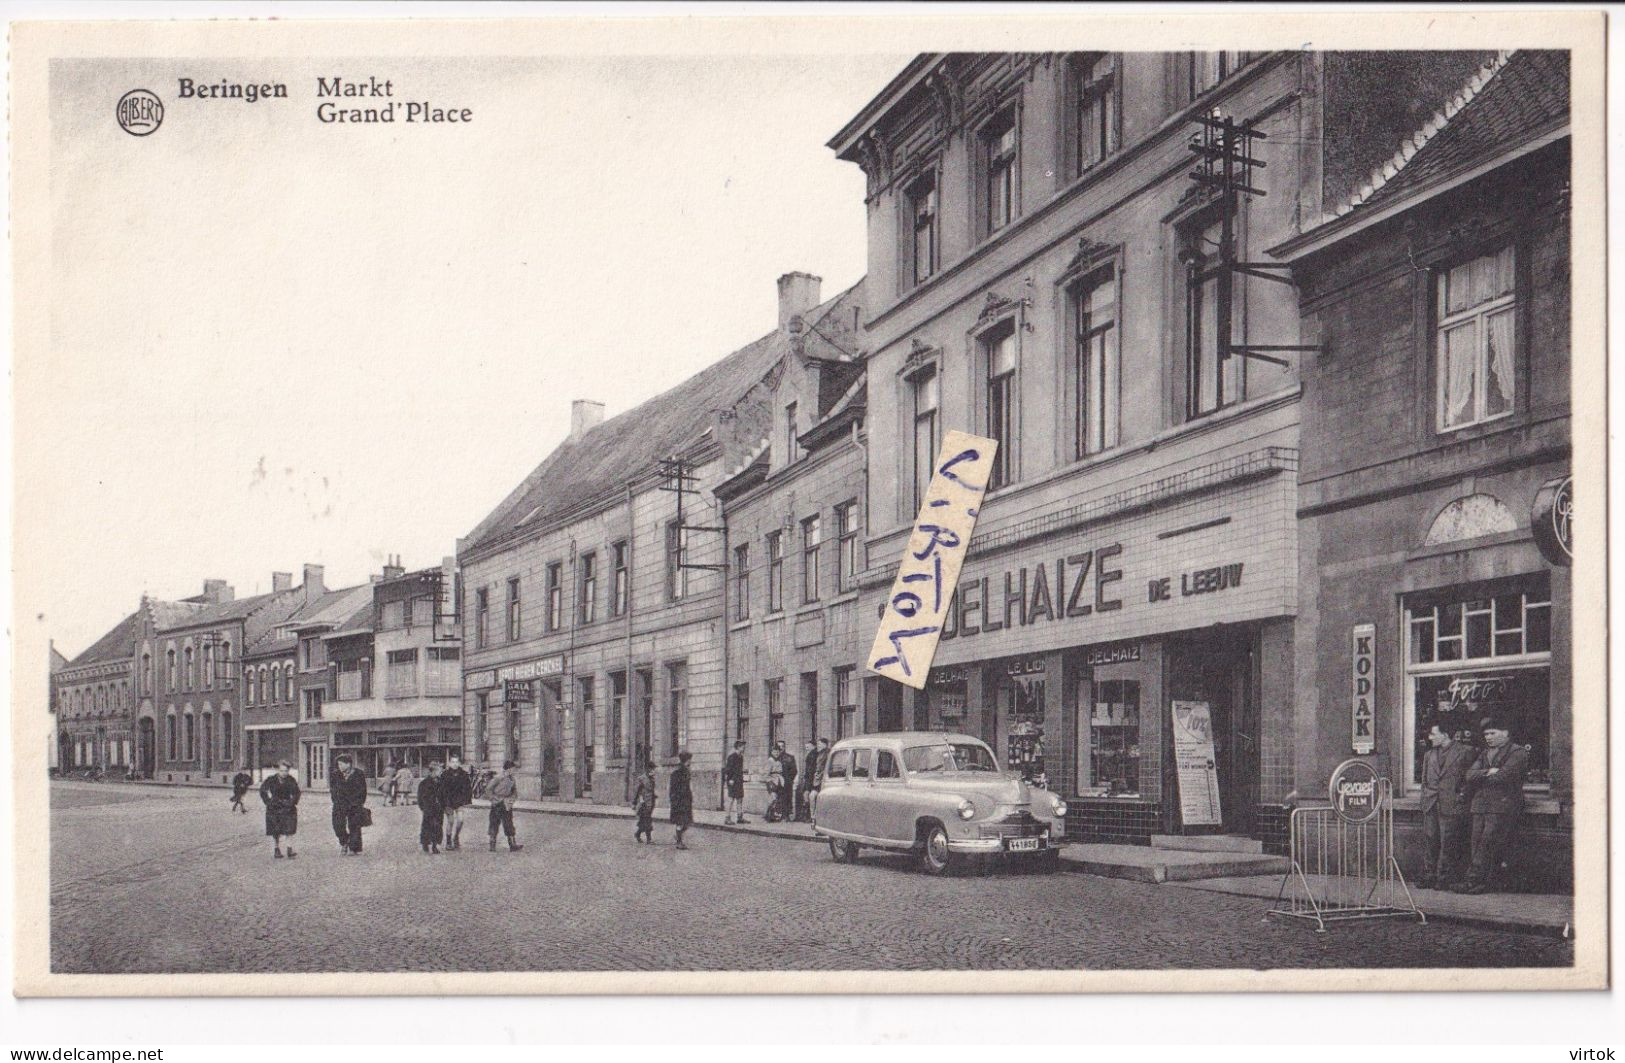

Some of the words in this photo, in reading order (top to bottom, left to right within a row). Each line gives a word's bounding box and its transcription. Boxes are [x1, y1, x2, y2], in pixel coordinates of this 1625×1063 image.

[178, 78, 288, 102] Beringen
[316, 77, 394, 97] Markt
[119, 92, 161, 126] ALBERT
[1148, 577, 1170, 603] DE
[1181, 562, 1244, 597] LEEUW
[1355, 636, 1372, 737] KODAK
[1348, 797, 1368, 806] FILM
